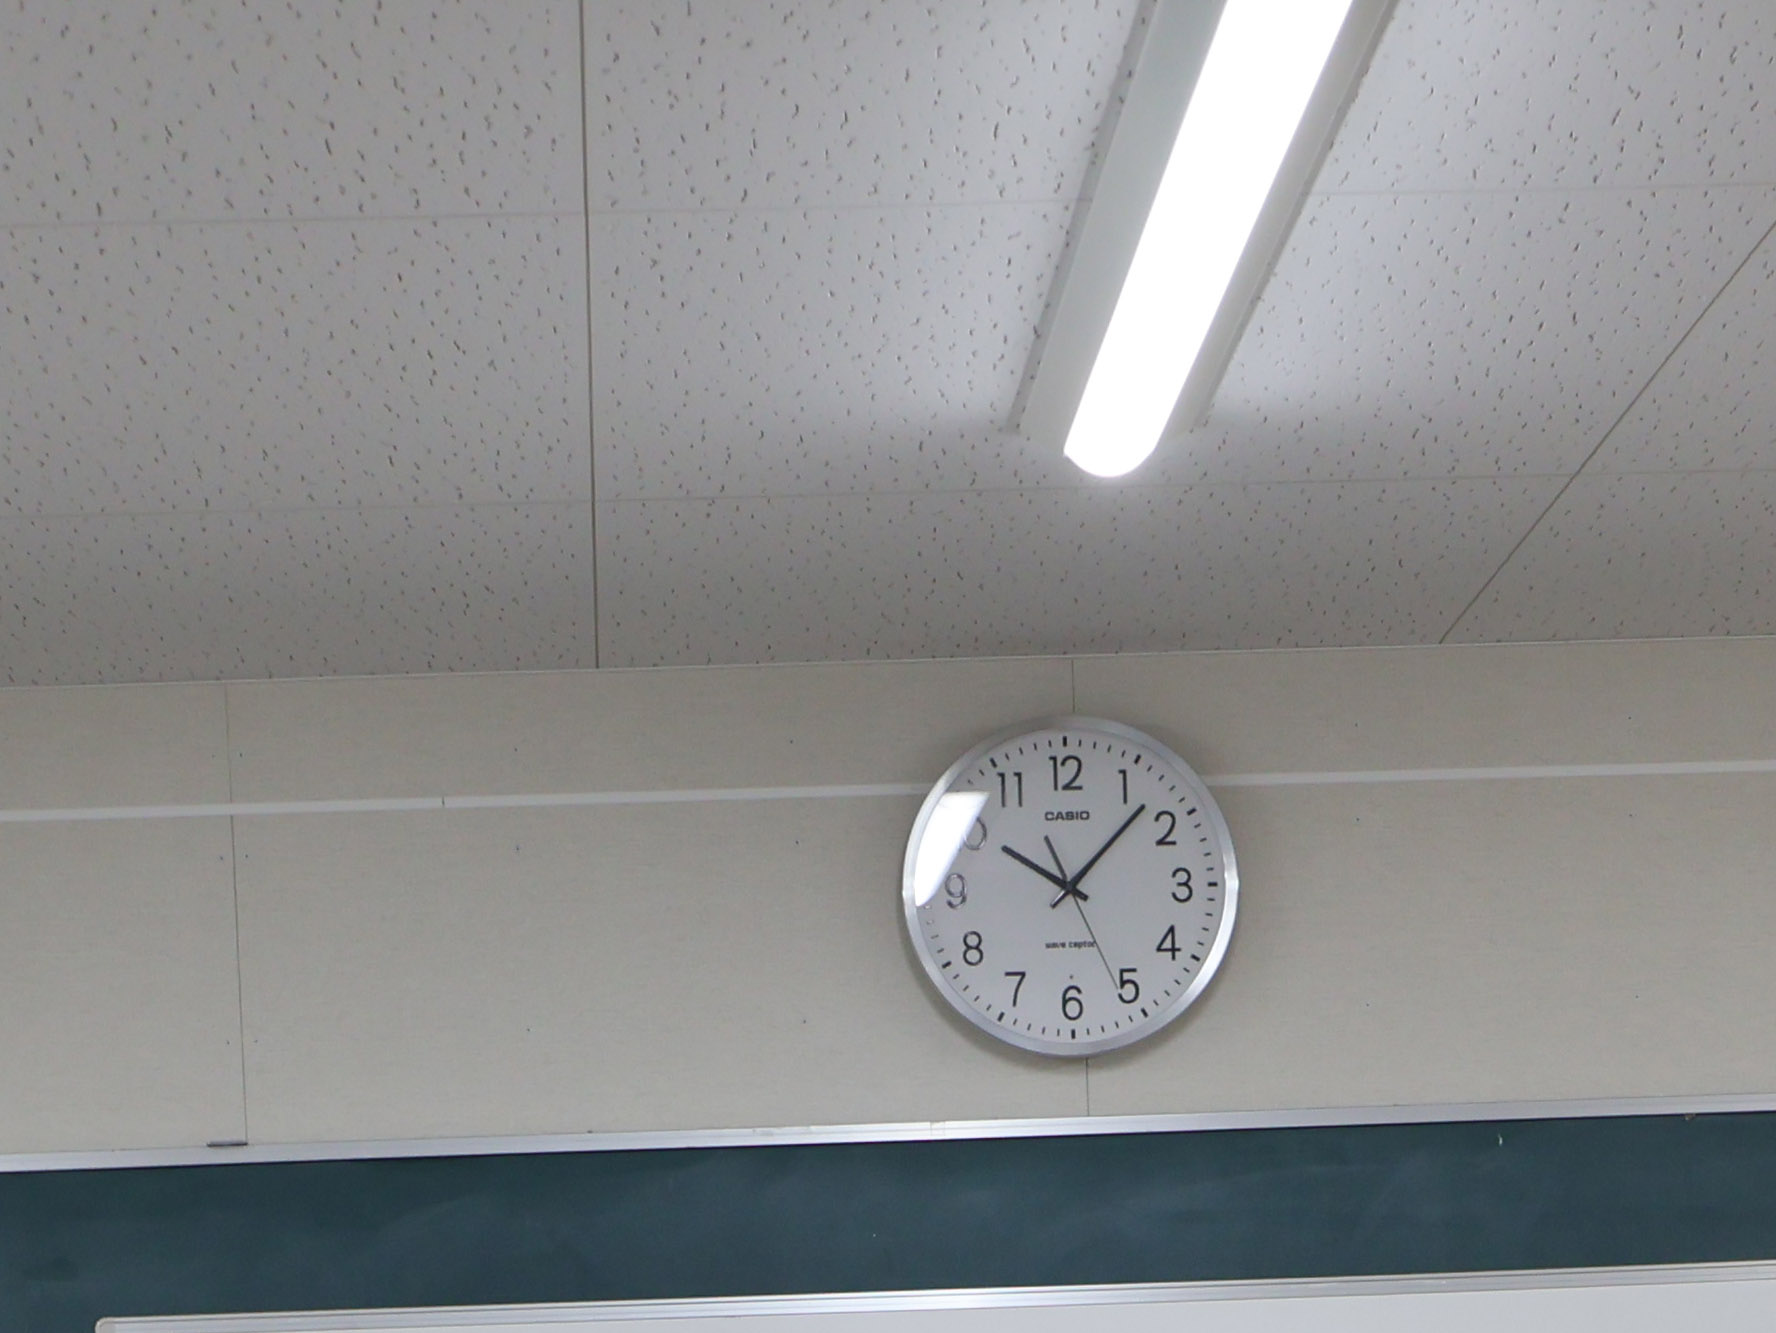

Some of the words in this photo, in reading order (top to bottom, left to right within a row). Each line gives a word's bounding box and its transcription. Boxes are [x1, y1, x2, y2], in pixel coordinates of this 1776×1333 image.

[998, 772, 1023, 808] 11
[1049, 755, 1083, 792] 12
[1118, 770, 1128, 805] 1
[1044, 810, 1090, 821] CASIO
[1154, 811, 1177, 846] 2
[944, 873, 967, 909] 9
[1171, 867, 1193, 903] 3
[962, 931, 984, 966] 8
[1156, 925, 1182, 961] 4
[1004, 972, 1026, 1007] 7
[1061, 984, 1083, 1020] 6
[1117, 968, 1140, 1004] 5
